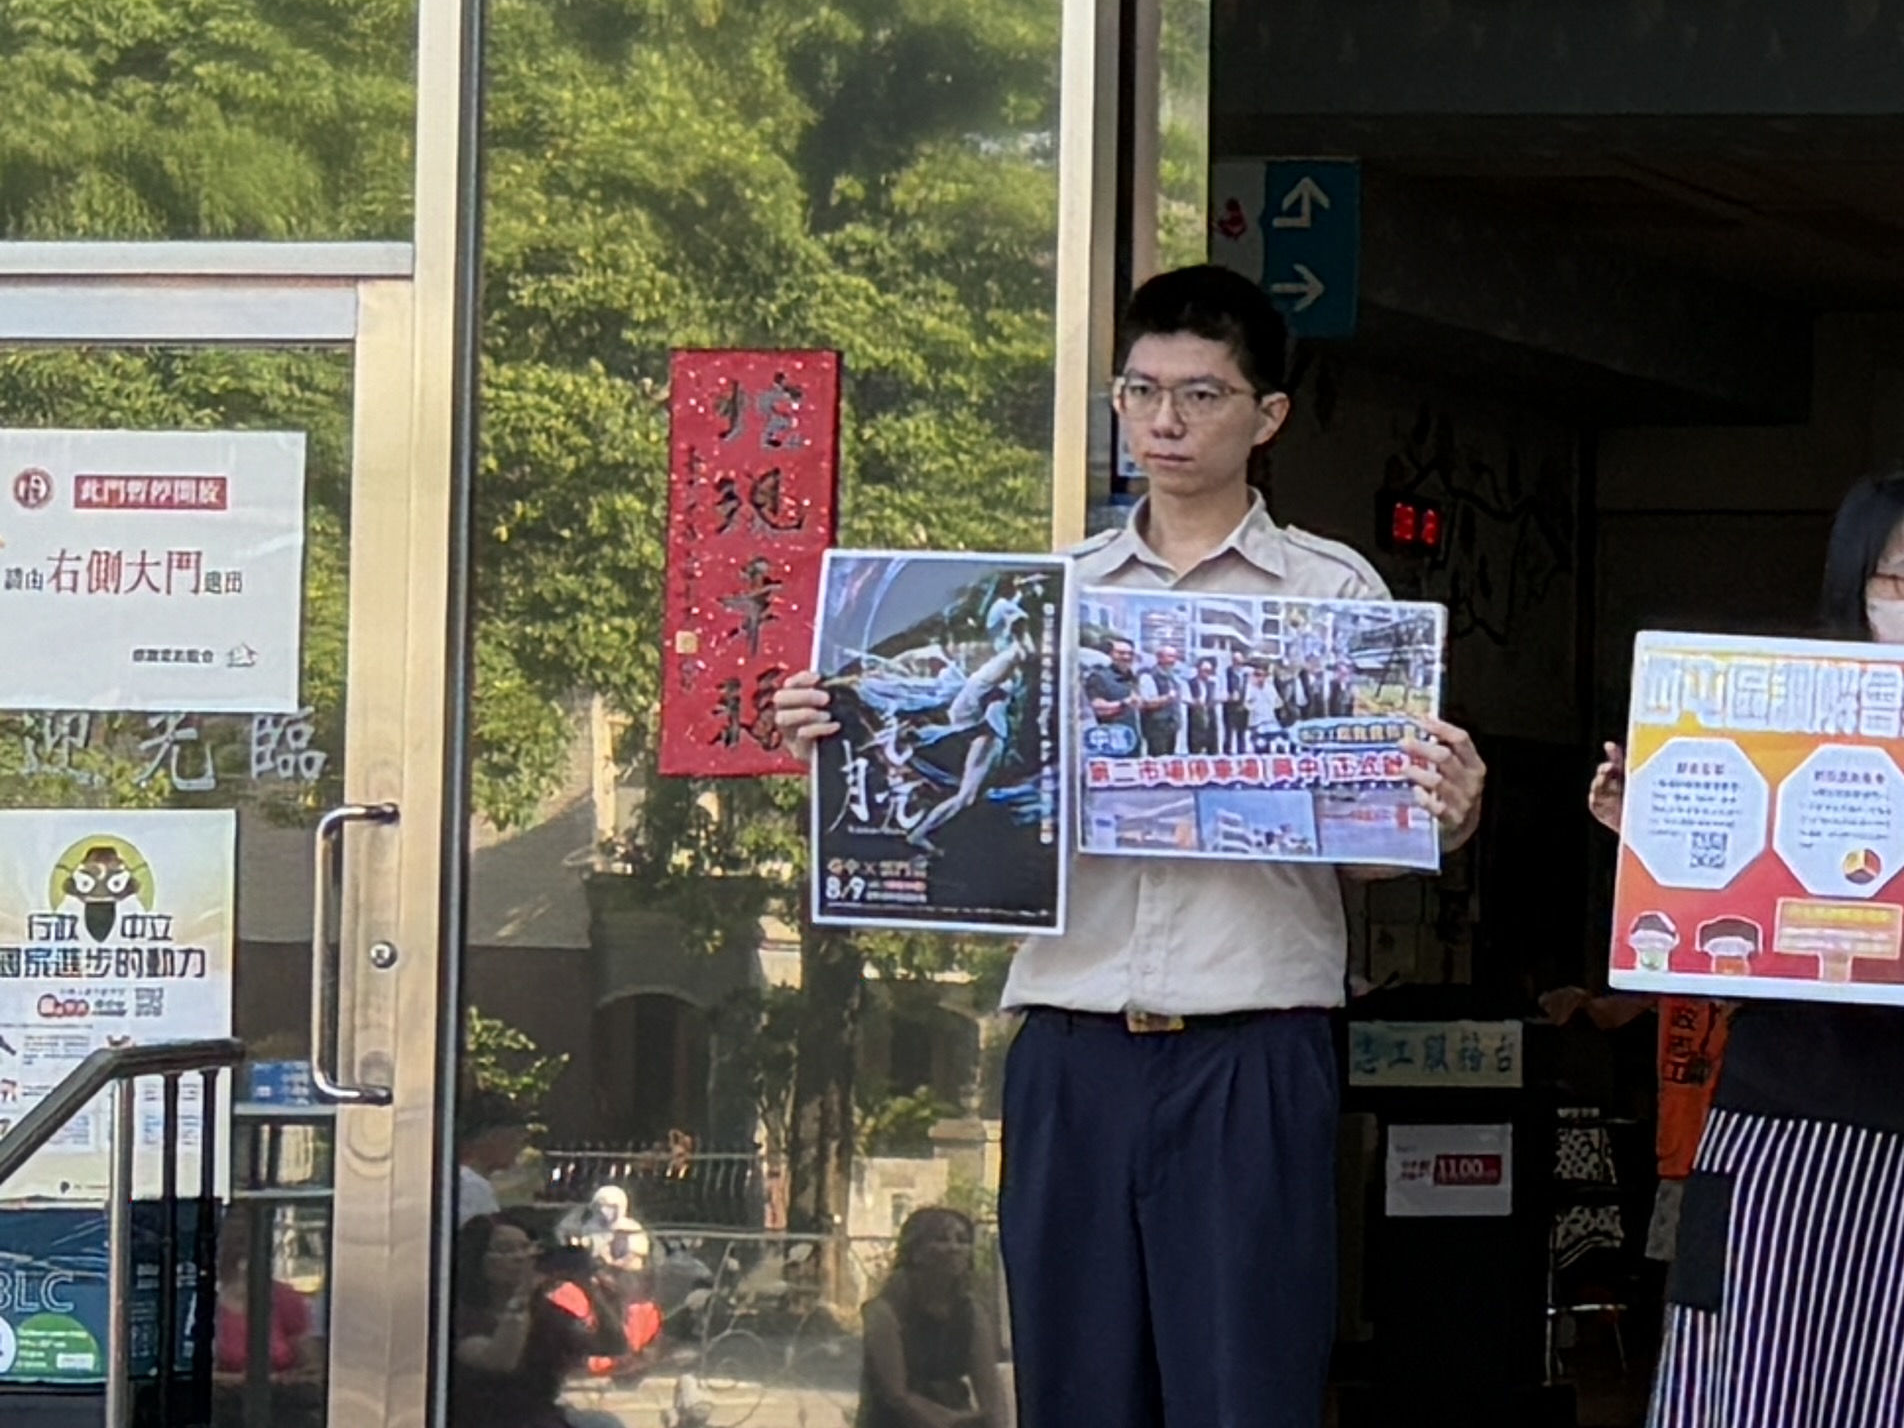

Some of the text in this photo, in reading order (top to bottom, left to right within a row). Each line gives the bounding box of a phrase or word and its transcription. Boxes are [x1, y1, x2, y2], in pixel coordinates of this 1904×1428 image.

[825, 876, 866, 901] 8/9
[27, 913, 173, 942] 行政 中立
